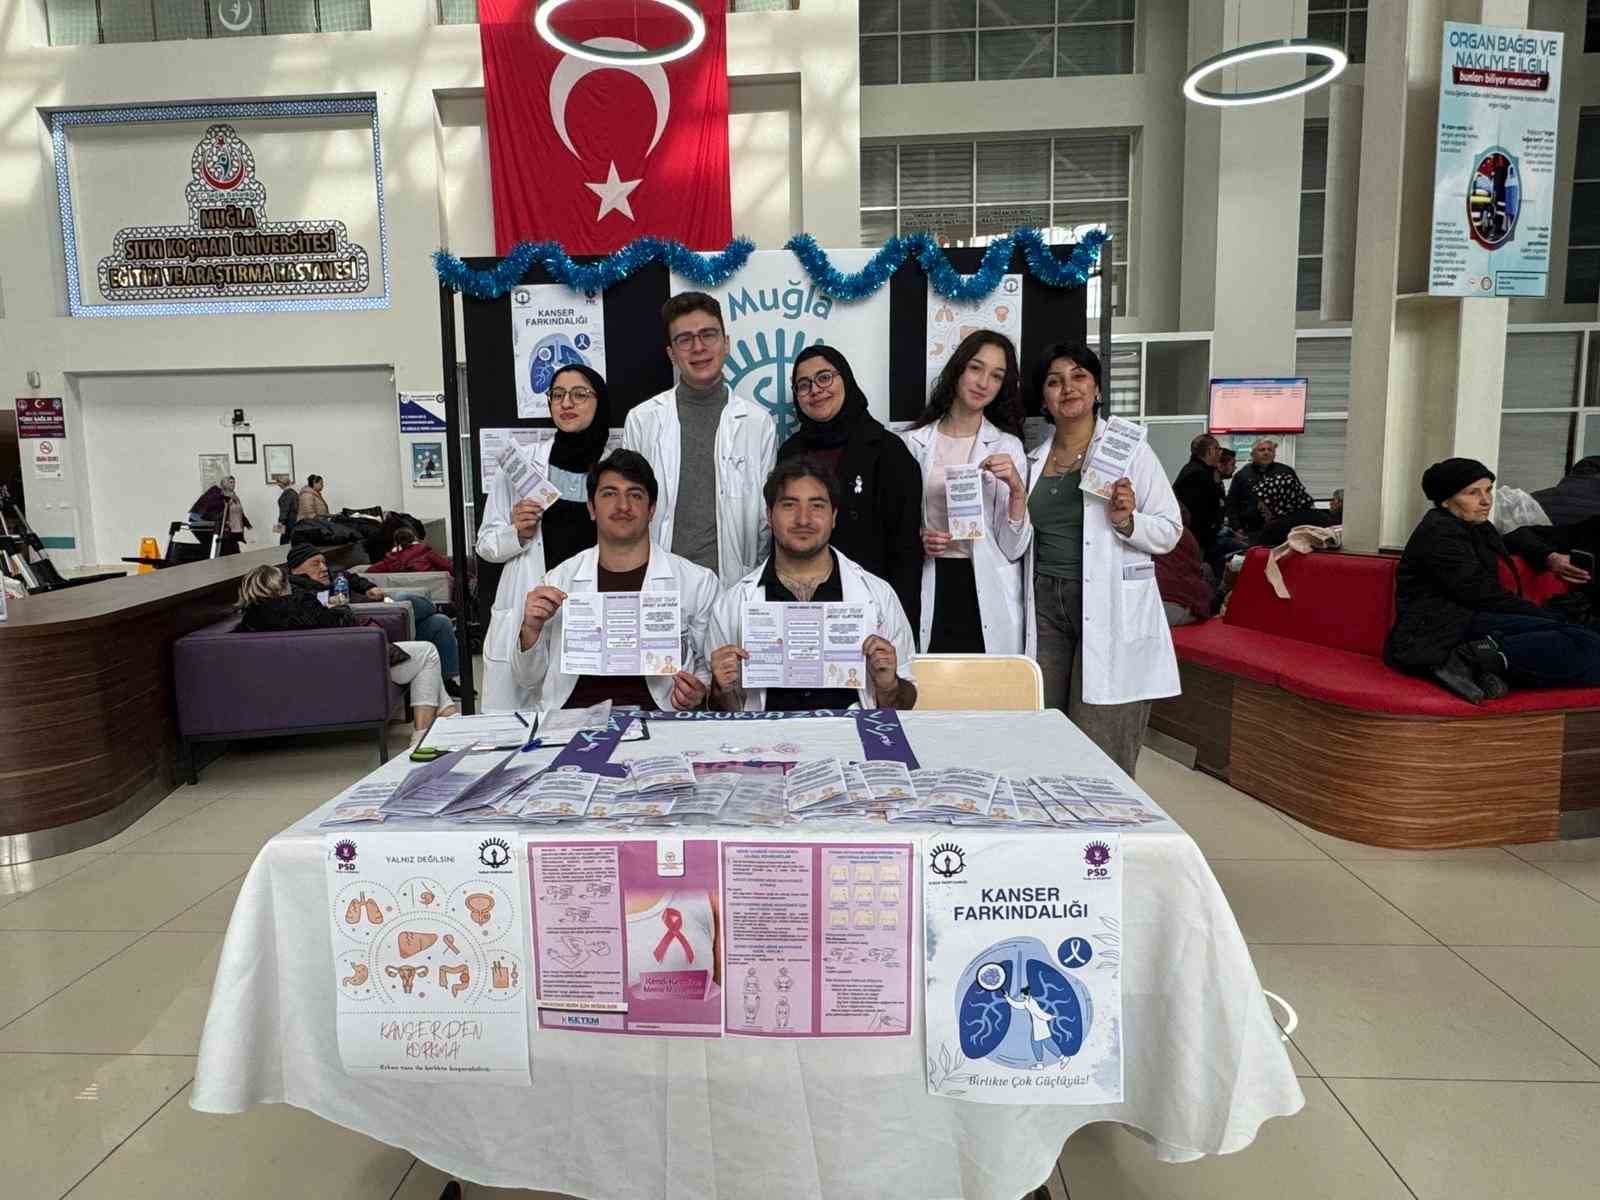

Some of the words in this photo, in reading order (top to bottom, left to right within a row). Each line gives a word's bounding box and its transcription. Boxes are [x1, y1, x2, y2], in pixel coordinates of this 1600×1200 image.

[1449, 31, 1495, 52] ORGAN
[1540, 40, 1557, 56] VE
[201, 205, 257, 230] MUĞLA
[126, 239, 164, 260] SITKI
[166, 237, 231, 262] KOÇMAN
[233, 229, 336, 257] ÜNİVERSİTESİ
[109, 265, 163, 288] EĞİTİM
[164, 266, 184, 286] VE
[185, 262, 274, 289] ARAŞTIRMA
[274, 256, 357, 284] HASTANESİ
[727, 279, 833, 322] Muğla
[525, 315, 588, 327] FARKINDALIĞI
[537, 308, 575, 318] KANSER
[338, 863, 356, 872] PSD
[385, 855, 415, 864] YALNIZ
[1087, 867, 1108, 876] PSD
[981, 887, 1060, 903] KANSER
[953, 900, 1089, 921] FARKINDALIĞI
[380, 1020, 482, 1040] KANSERDEN
[968, 1074, 1009, 1087] Birlikte
[1011, 1076, 1033, 1088] Çok
[1035, 1073, 1090, 1089] Güçlüyüz!
